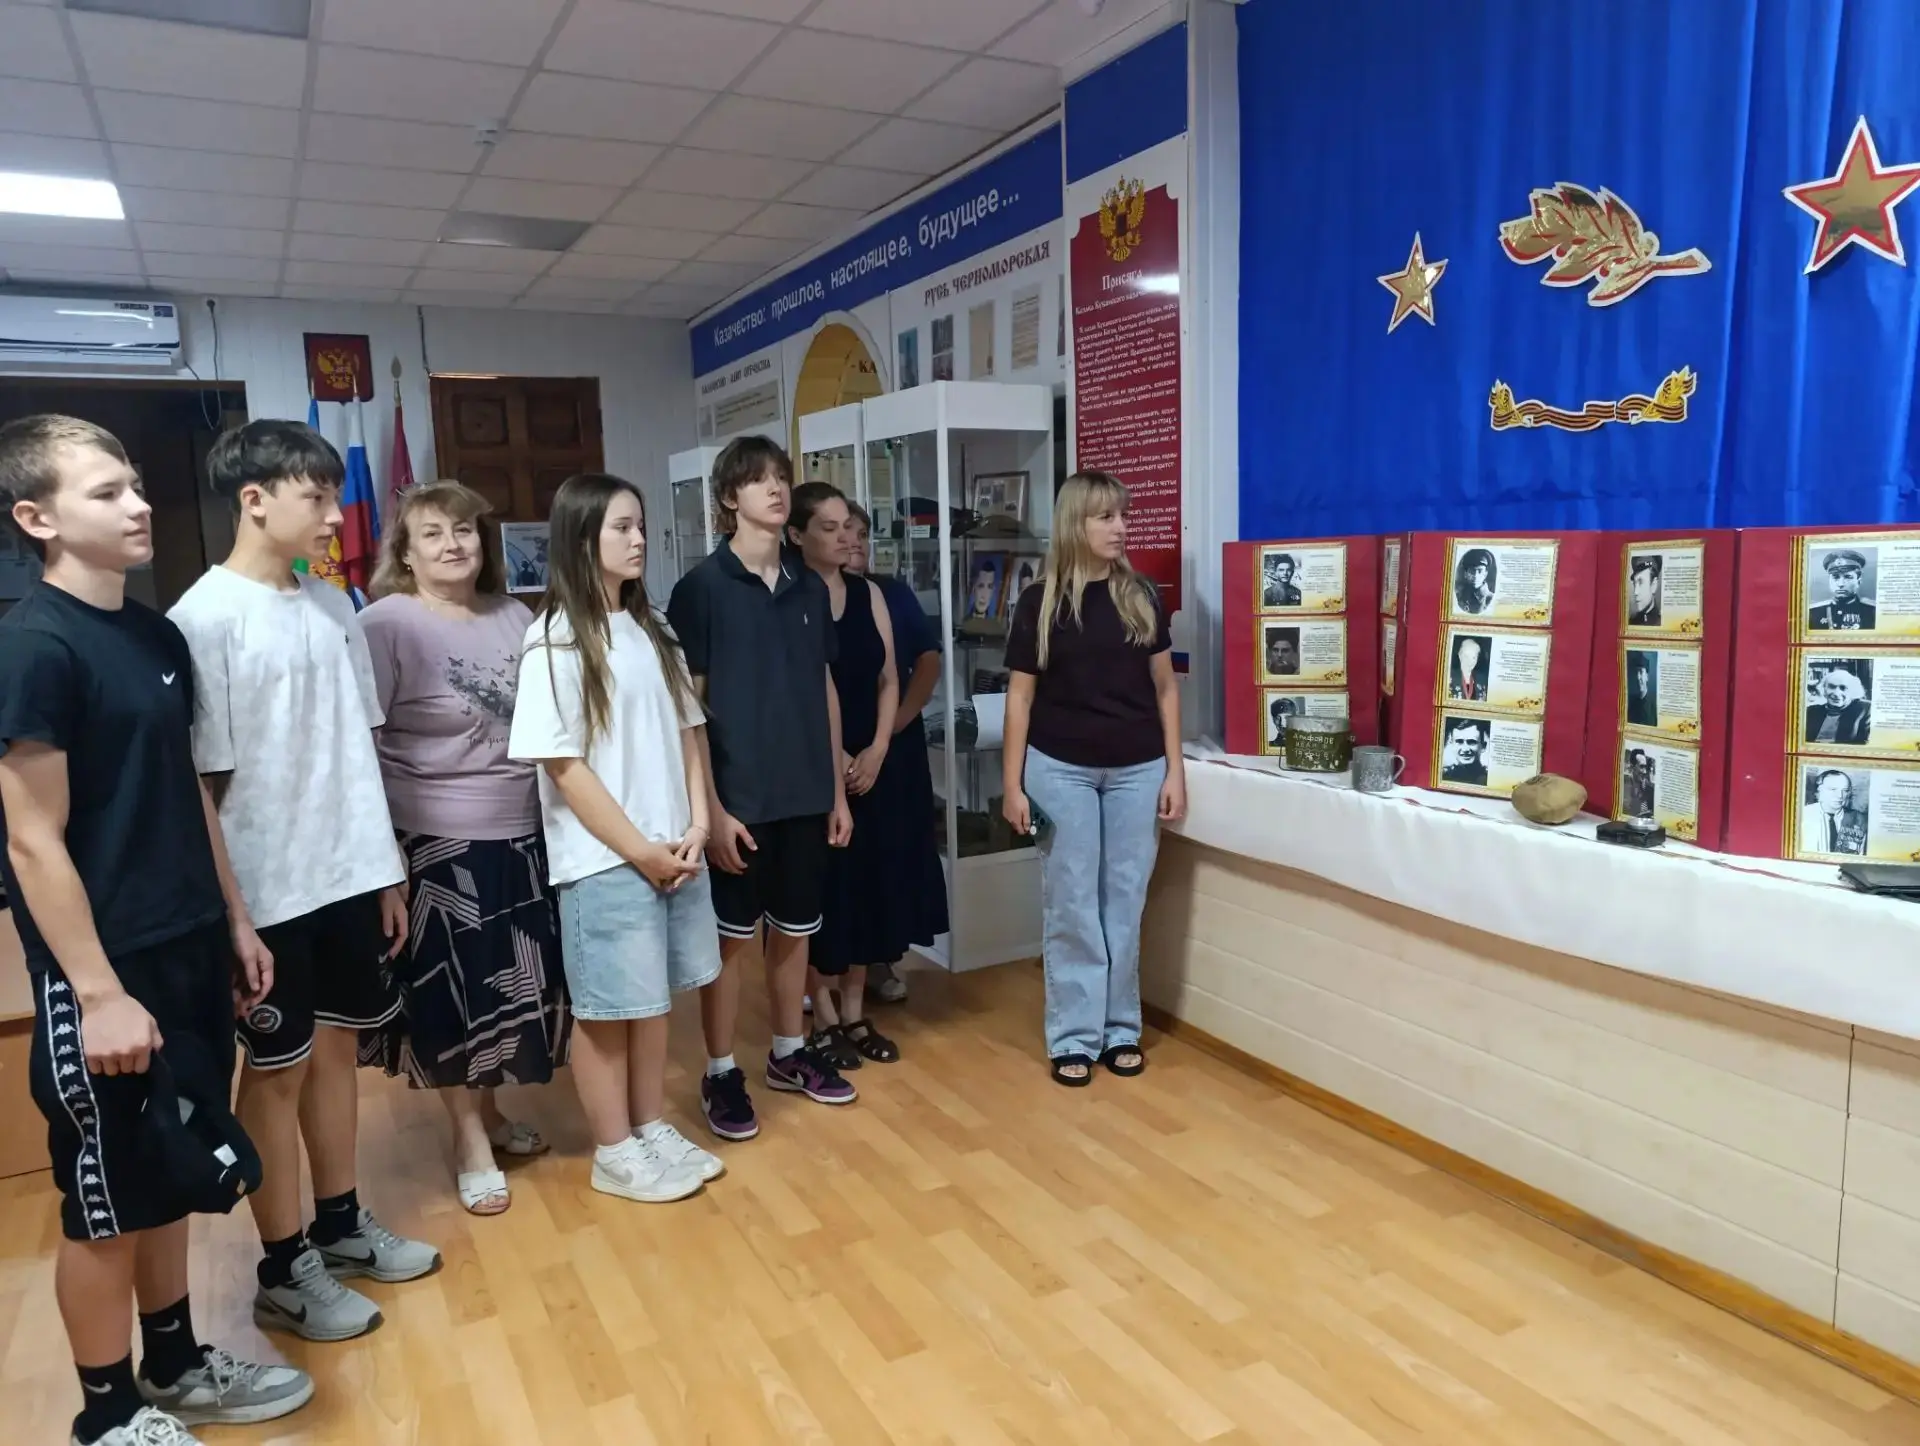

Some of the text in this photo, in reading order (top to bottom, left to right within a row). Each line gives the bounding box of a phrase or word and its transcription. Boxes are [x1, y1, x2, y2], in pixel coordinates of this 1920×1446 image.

[713, 307, 766, 347] Казачество:
[771, 279, 825, 321] прошлое,
[830, 235, 912, 289] настоящее,
[924, 239, 1051, 308] РУСЬ ЧЕРНОМОРСКАЯ
[1101, 269, 1143, 292] Присяга
